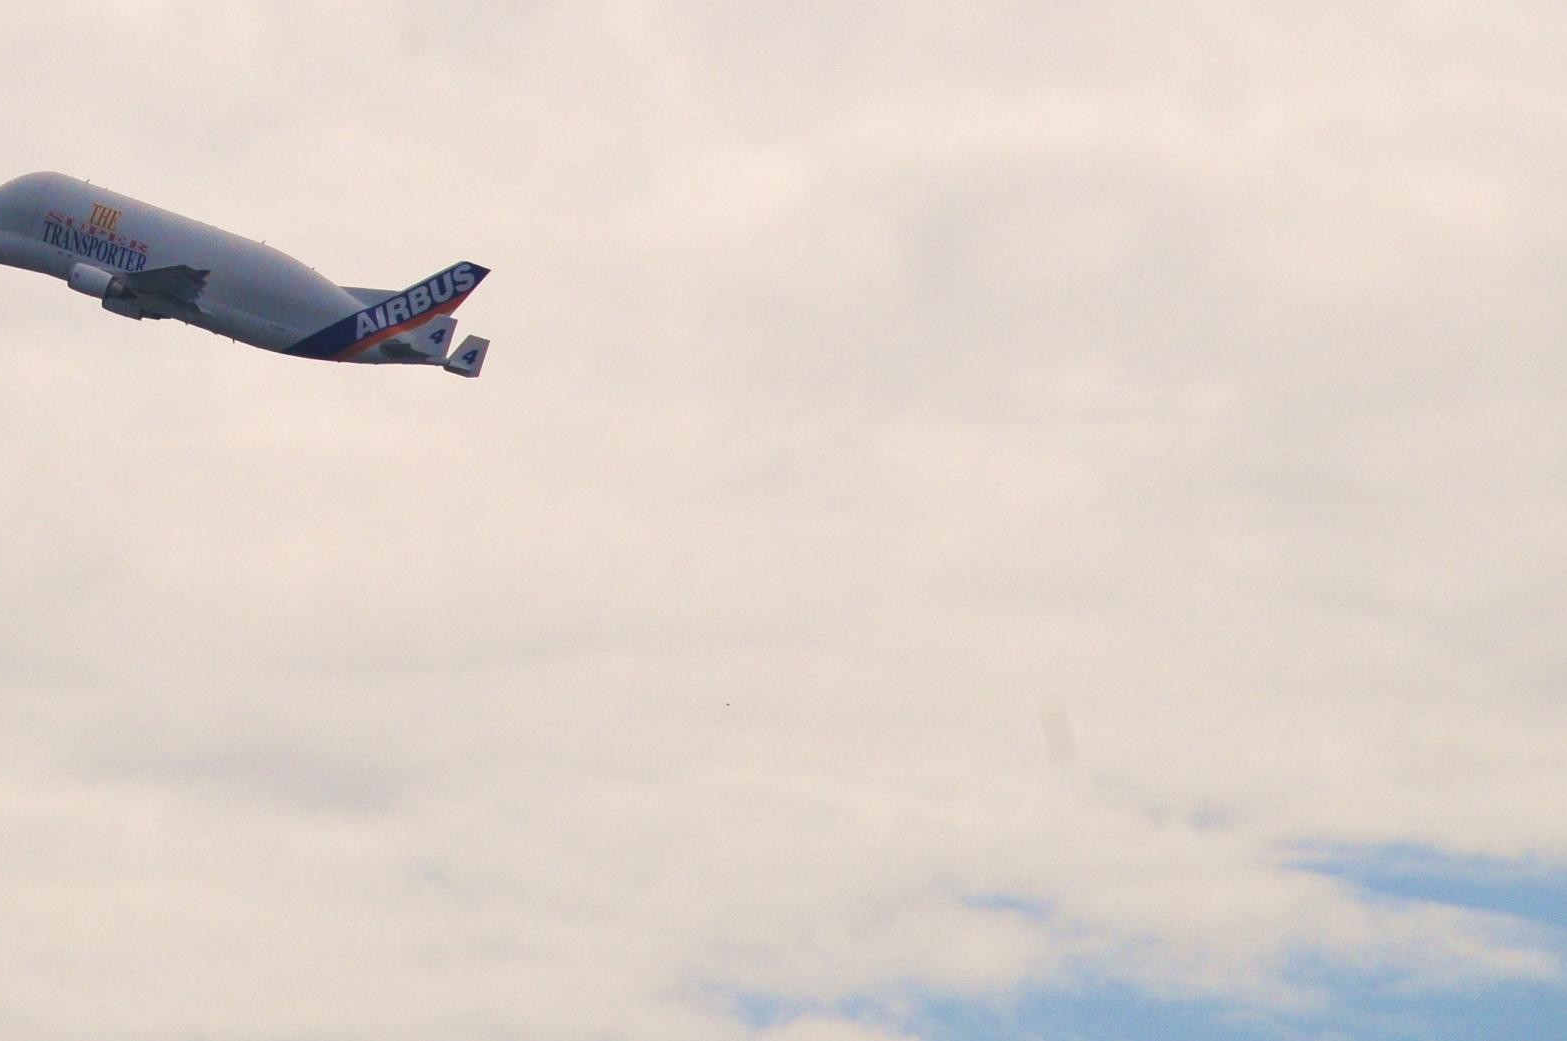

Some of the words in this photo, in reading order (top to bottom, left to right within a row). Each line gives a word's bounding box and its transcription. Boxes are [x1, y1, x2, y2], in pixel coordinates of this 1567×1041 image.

[89, 203, 121, 230] THE
[43, 220, 147, 271] TRANSPORTER
[356, 264, 475, 339] AIRBUS
[430, 329, 445, 344] 4
[462, 350, 478, 364] 4
